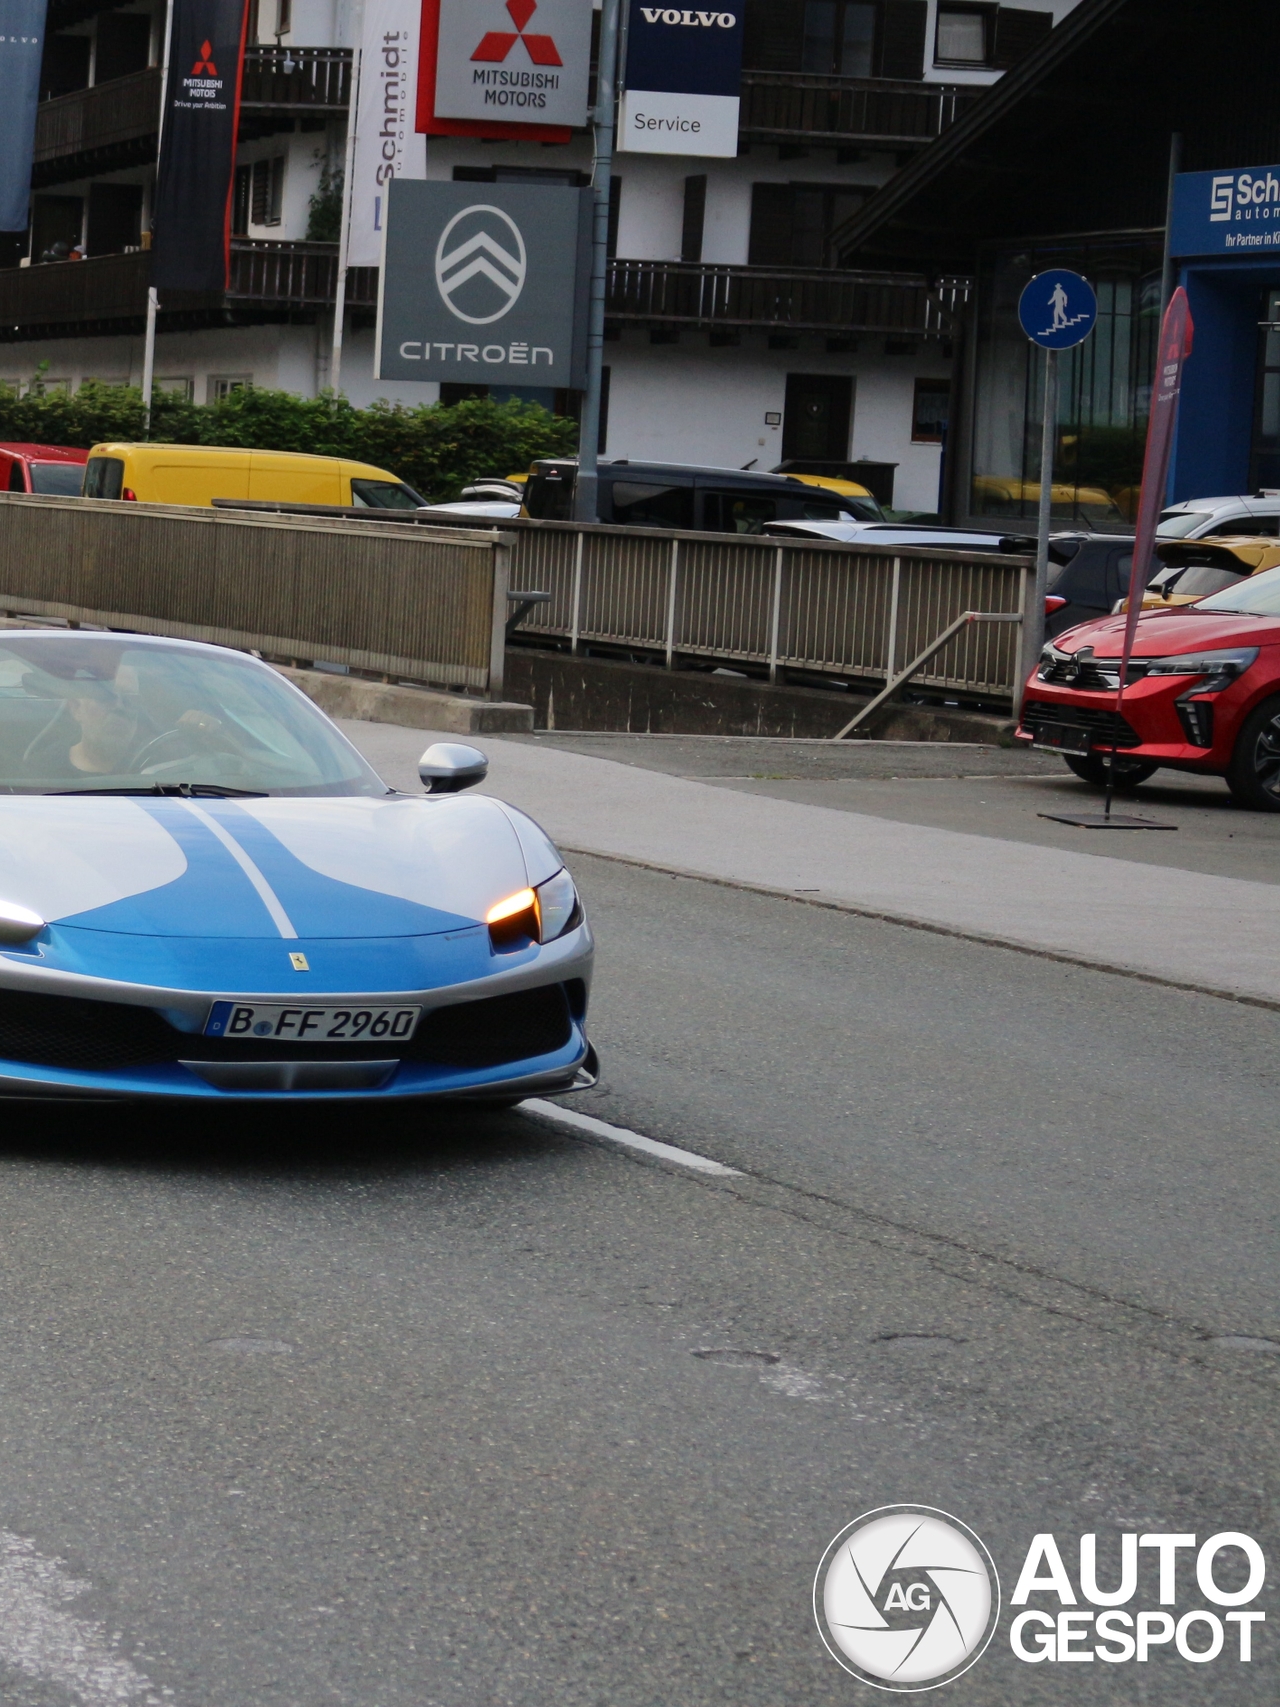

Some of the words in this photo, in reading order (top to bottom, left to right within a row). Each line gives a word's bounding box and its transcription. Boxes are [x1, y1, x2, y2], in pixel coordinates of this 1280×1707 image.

[640, 8, 737, 28] VOLVO
[183, 78, 223, 88] MITSUBSHI
[473, 69, 559, 90] MITSUBISHI
[376, 30, 400, 187] Schmidt
[397, 31, 408, 171] utomobile
[484, 90, 547, 108] MOTORS
[634, 113, 701, 133] Service
[1236, 172, 1280, 205] Sch
[1225, 233, 1236, 247] Ihr
[1237, 233, 1263, 246] Partner
[1264, 231, 1271, 245] in
[399, 342, 554, 365] CITROËN
[229, 1007, 254, 1033] B
[274, 1009, 325, 1037] FF
[327, 1010, 415, 1038] 2960
